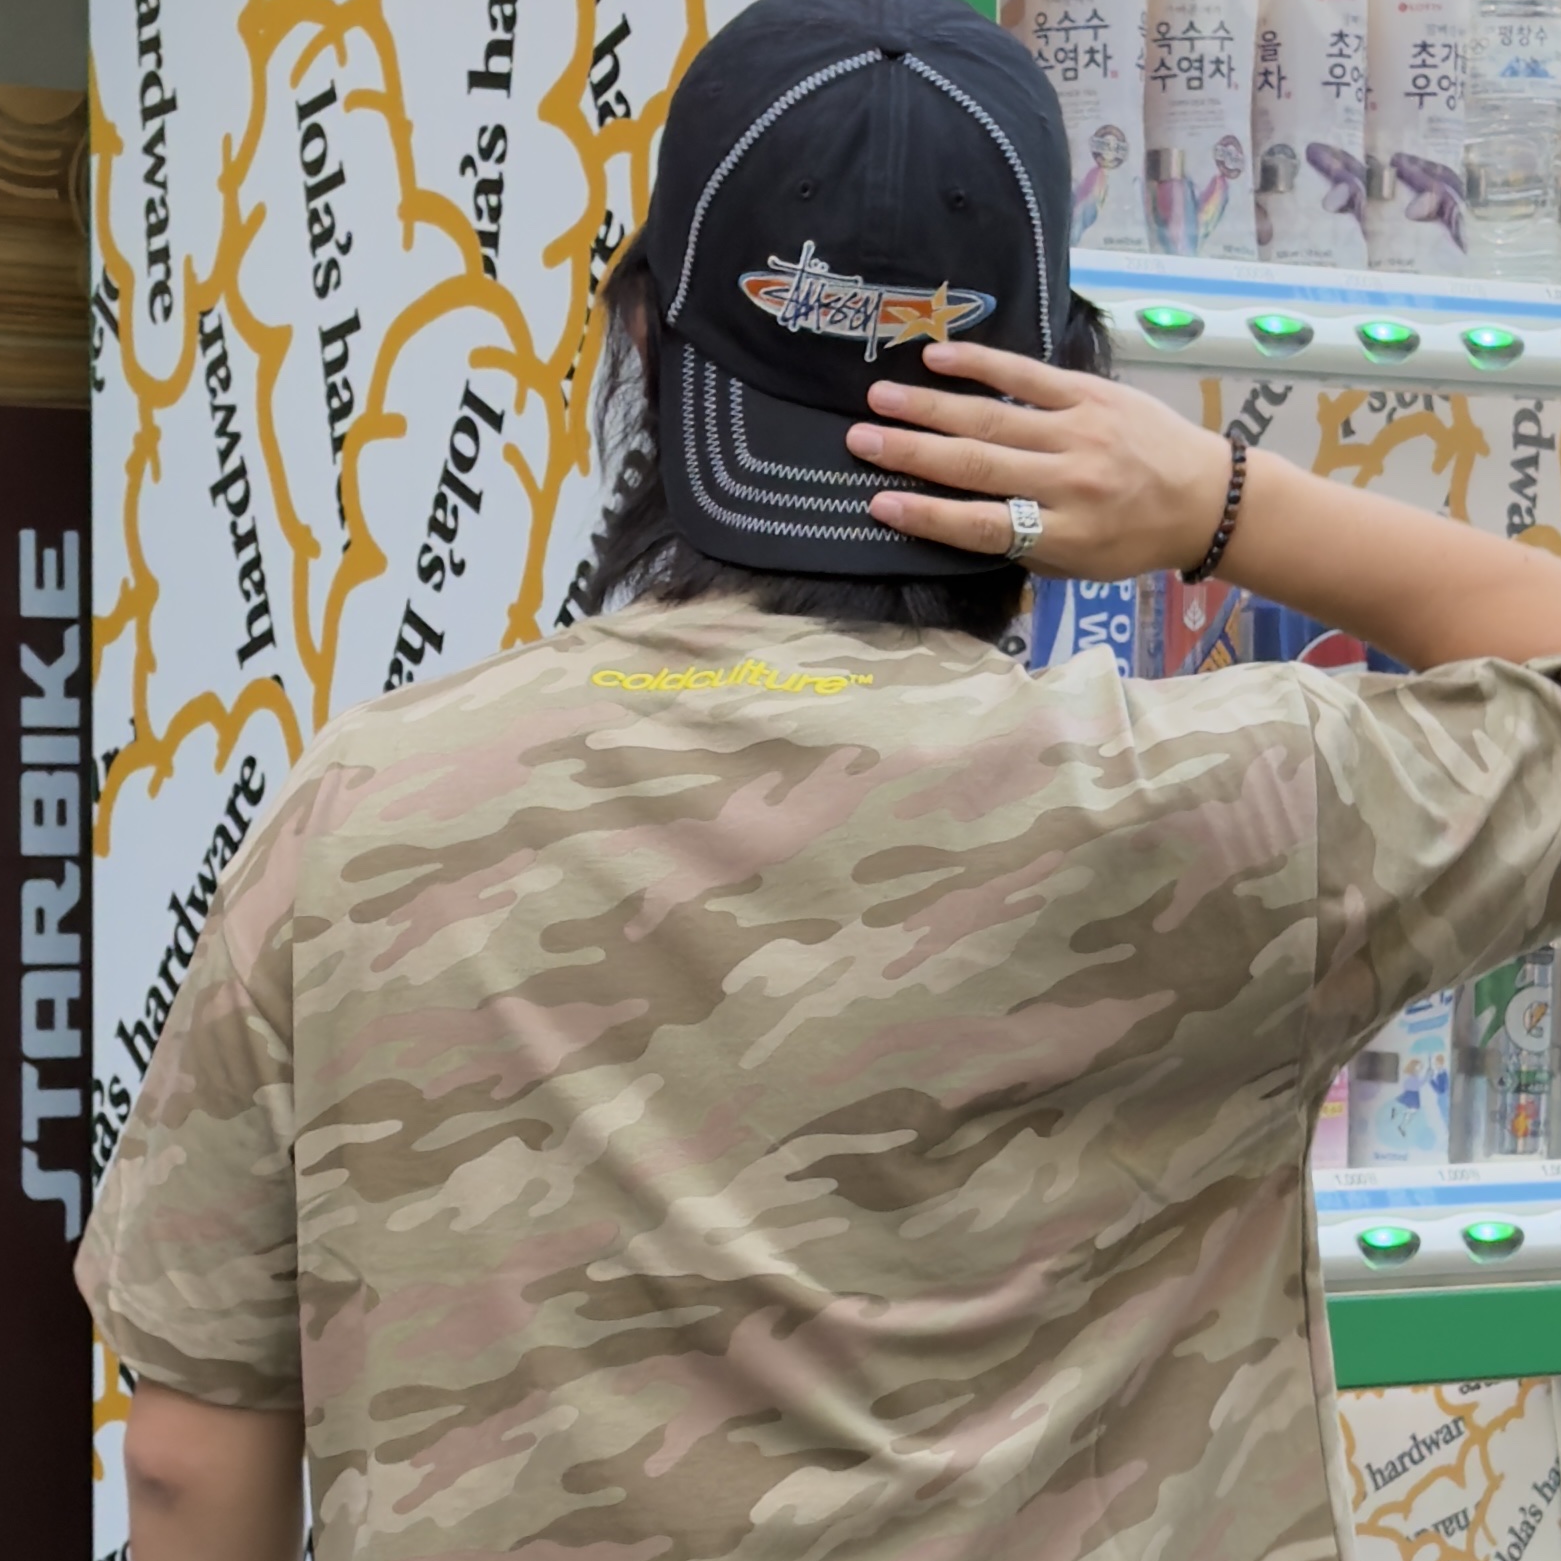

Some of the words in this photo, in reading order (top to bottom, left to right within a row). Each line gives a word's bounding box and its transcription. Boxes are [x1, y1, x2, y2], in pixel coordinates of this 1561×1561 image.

[1032, 8, 1110, 47] 옥수수
[1151, 20, 1235, 55] 옥수수
[1150, 53, 1236, 94] 수염차
[1403, 73, 1465, 112] 우엉
[294, 78, 348, 300] lola's
[414, 380, 507, 593] lola's
[20, 527, 82, 1241] STARBIKE
